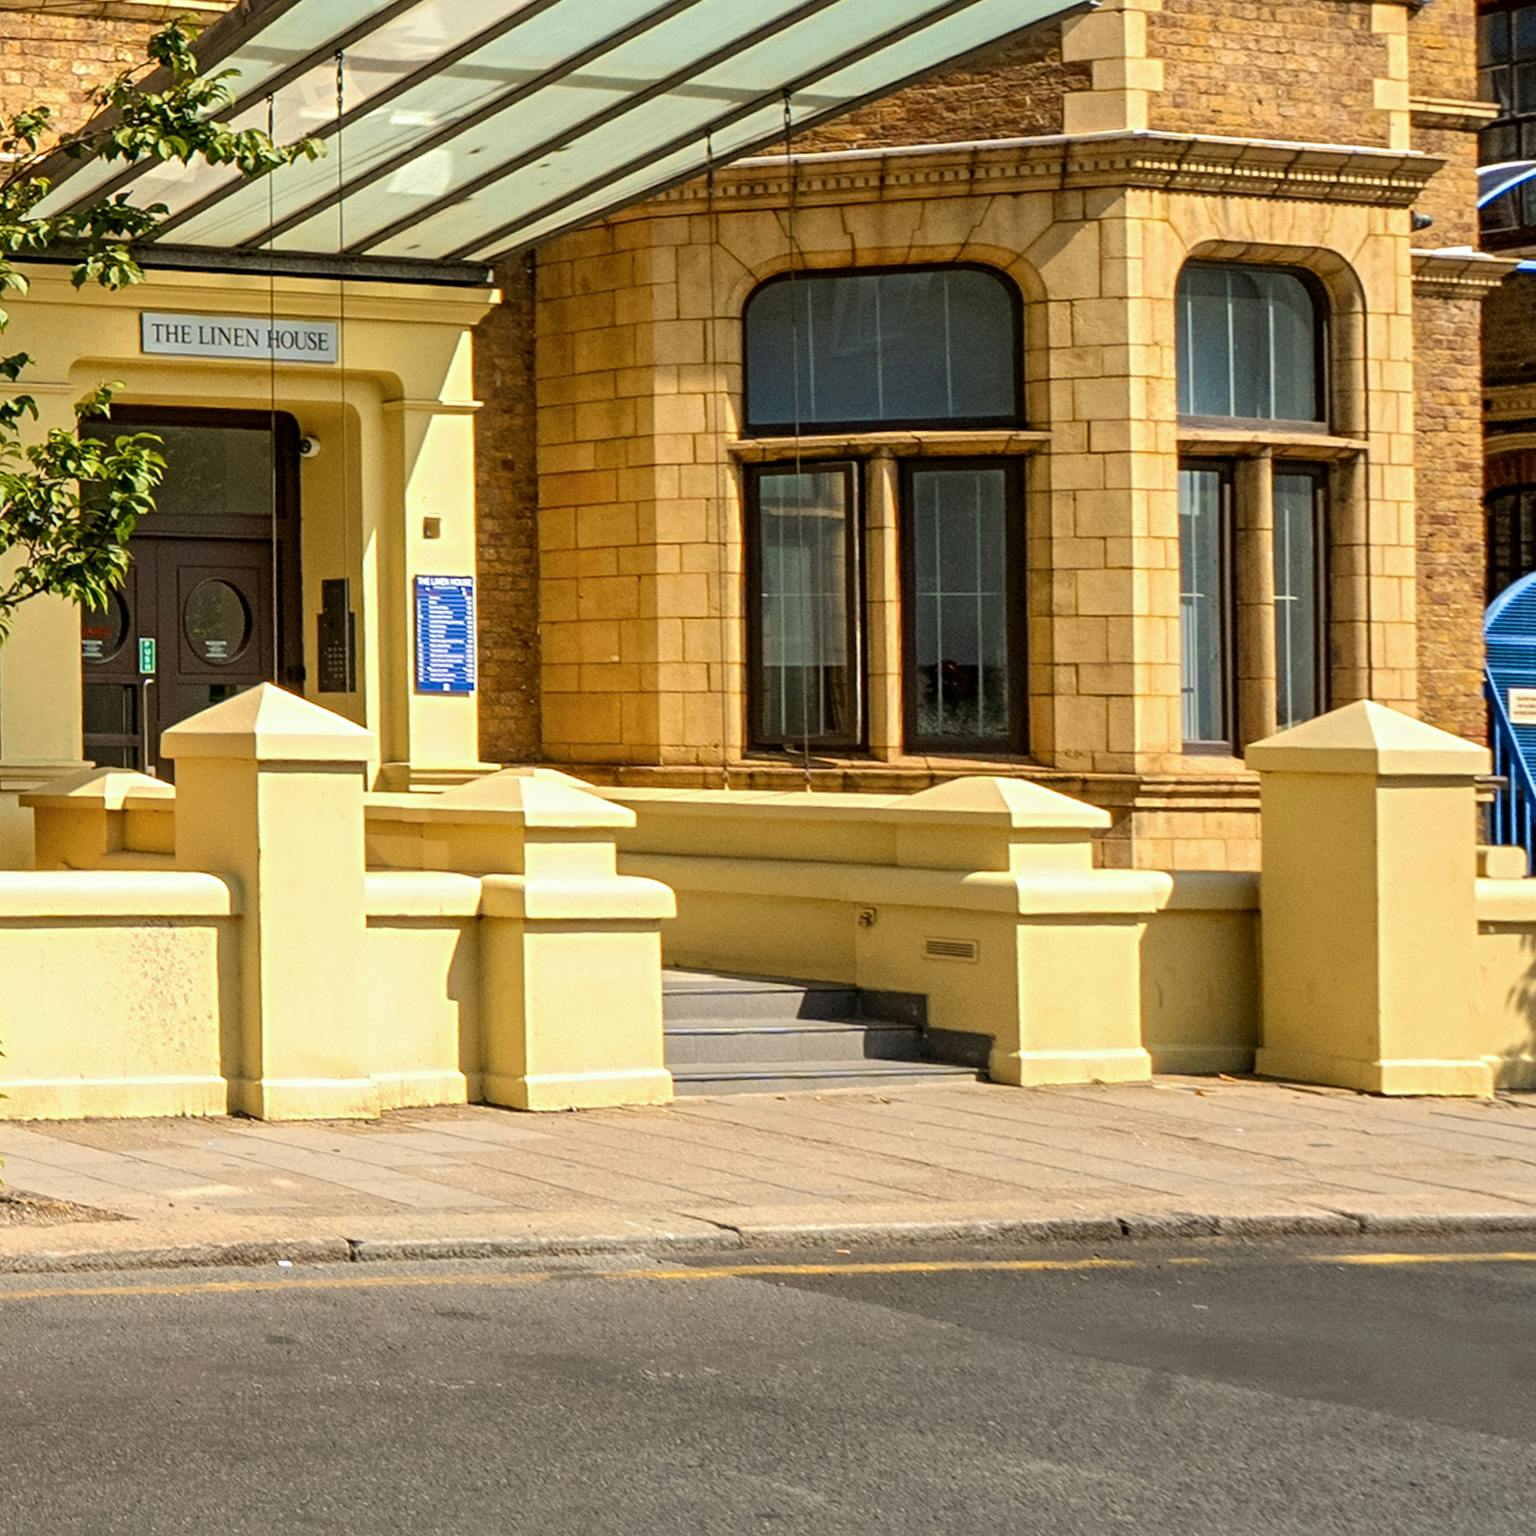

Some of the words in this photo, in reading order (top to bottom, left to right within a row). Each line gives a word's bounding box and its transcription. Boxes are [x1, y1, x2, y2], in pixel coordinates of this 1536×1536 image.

[151, 323, 192, 344] THE
[198, 325, 259, 348] LINEN
[267, 329, 329, 352] HOUSE
